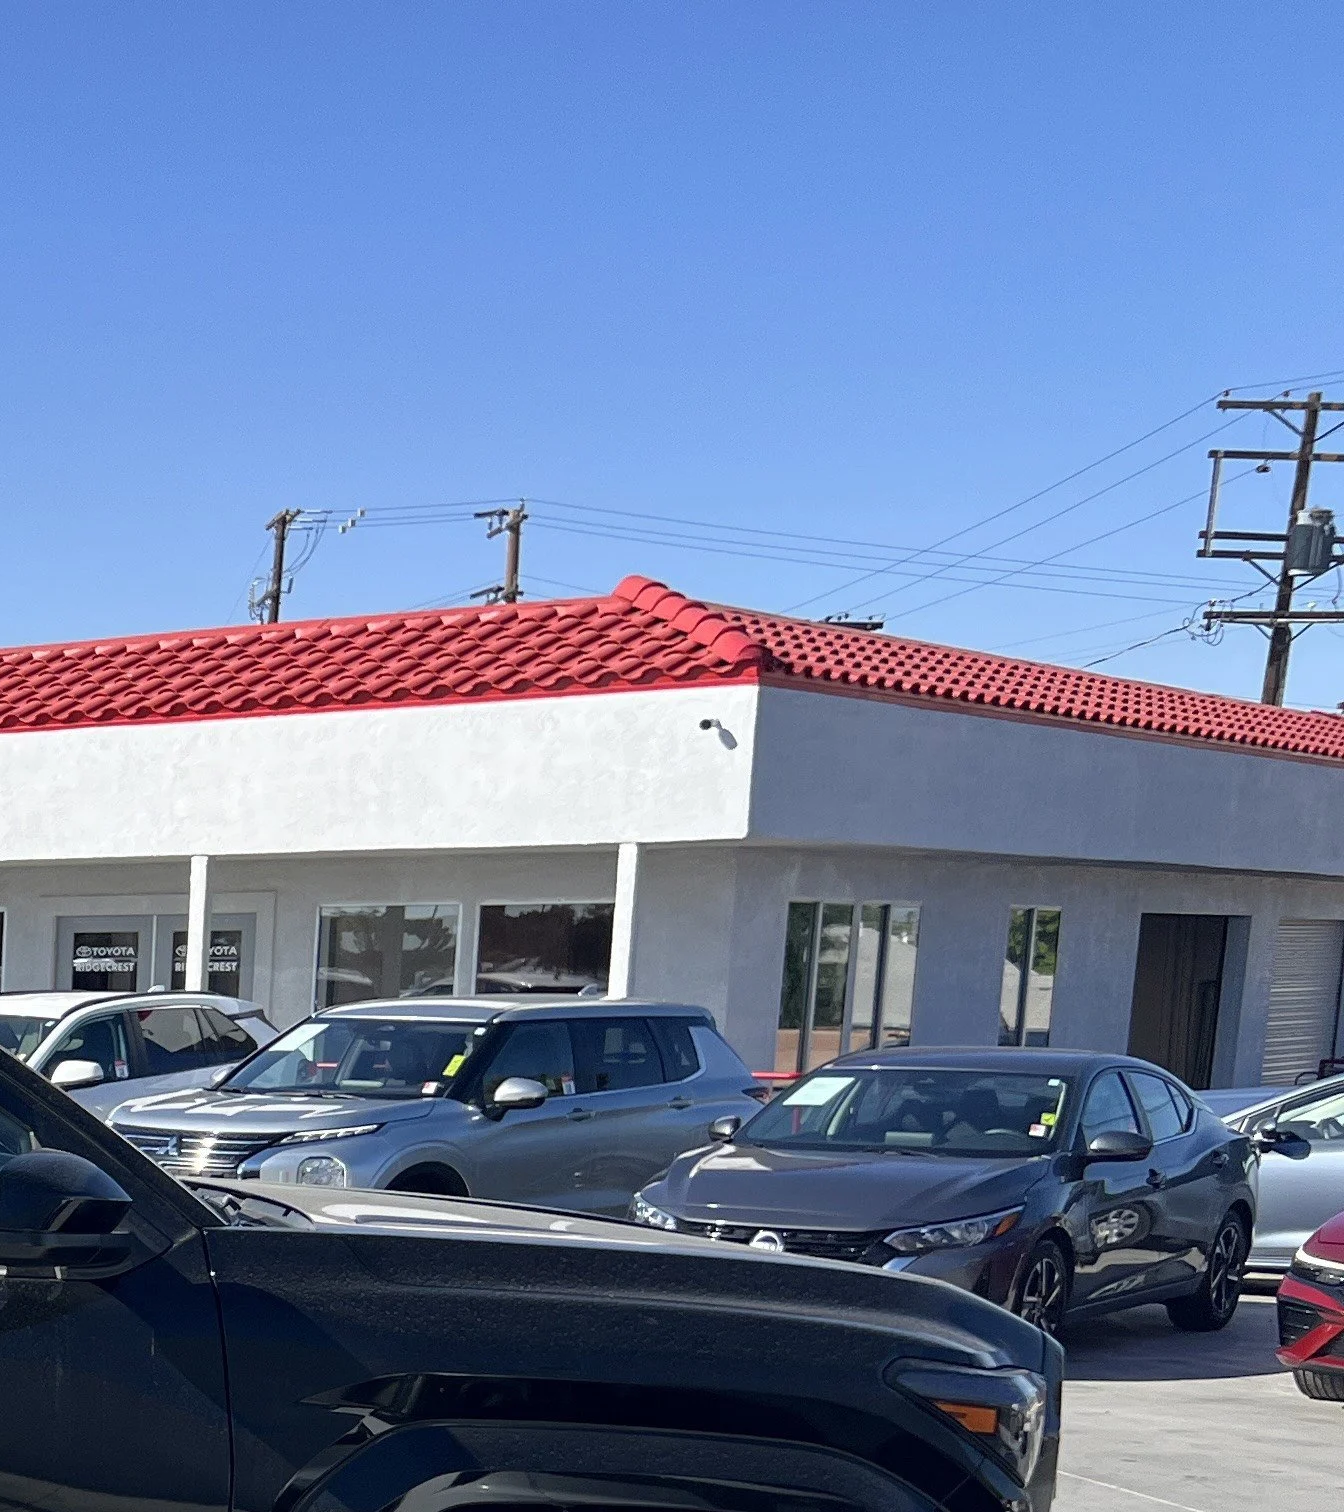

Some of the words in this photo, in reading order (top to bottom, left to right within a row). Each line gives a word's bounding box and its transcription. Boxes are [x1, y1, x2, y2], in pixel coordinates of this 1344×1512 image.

[92, 946, 135, 956] TOYOTA
[208, 946, 238, 956] YOTA
[75, 961, 135, 972] RIDGECREST
[175, 960, 238, 972] RICREST
